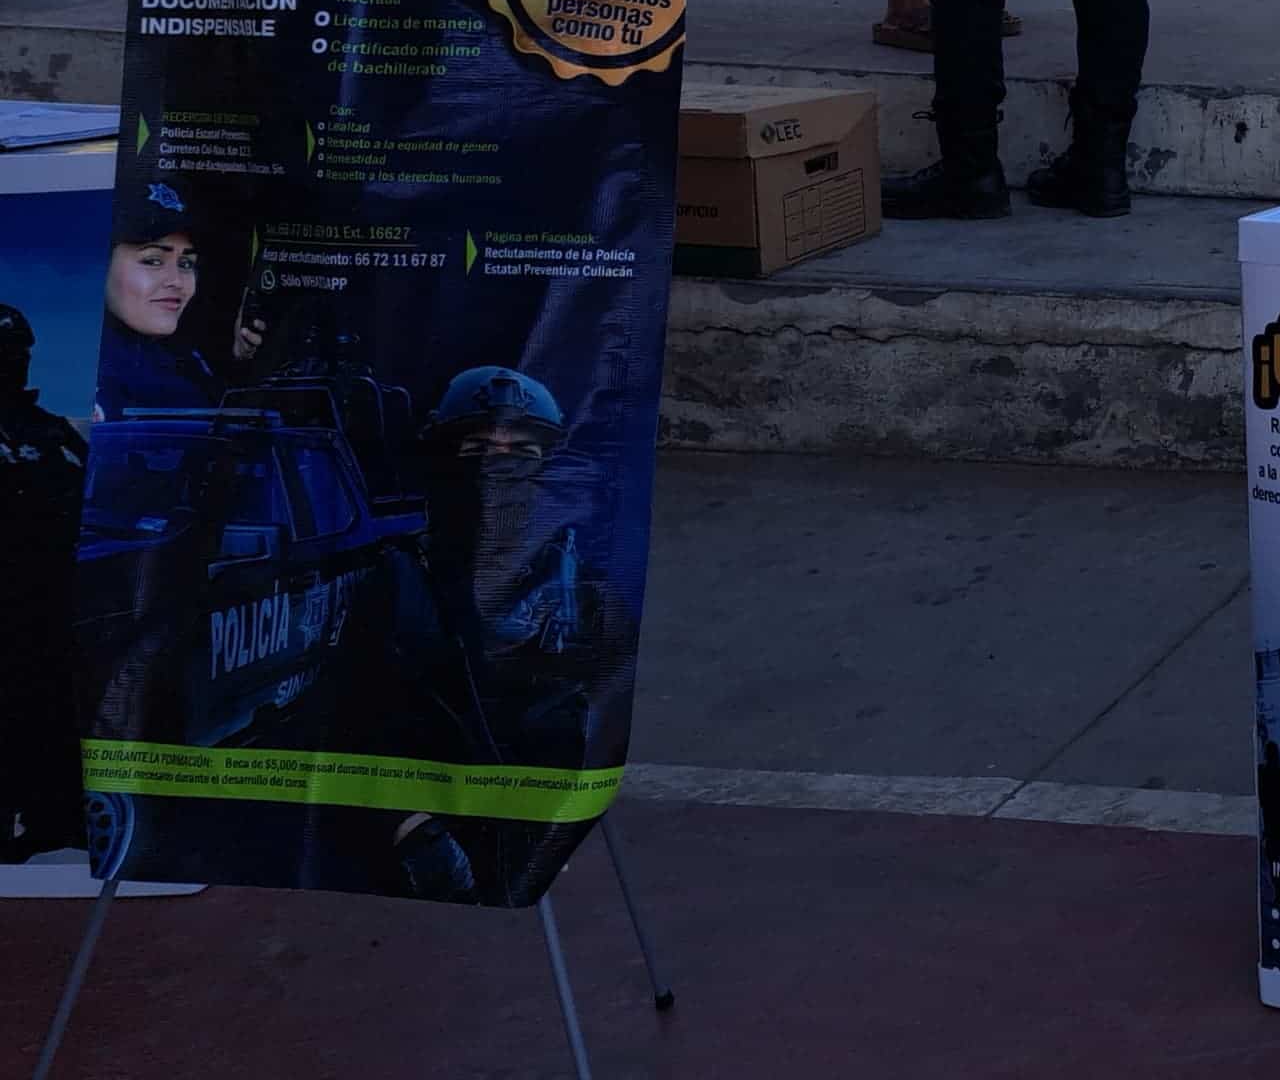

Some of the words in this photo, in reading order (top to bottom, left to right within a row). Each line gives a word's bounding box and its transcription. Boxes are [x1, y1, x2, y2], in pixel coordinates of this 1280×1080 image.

[140, 16, 276, 38] INDISPENSABLE
[551, 18, 615, 42] como
[621, 21, 645, 46] tú
